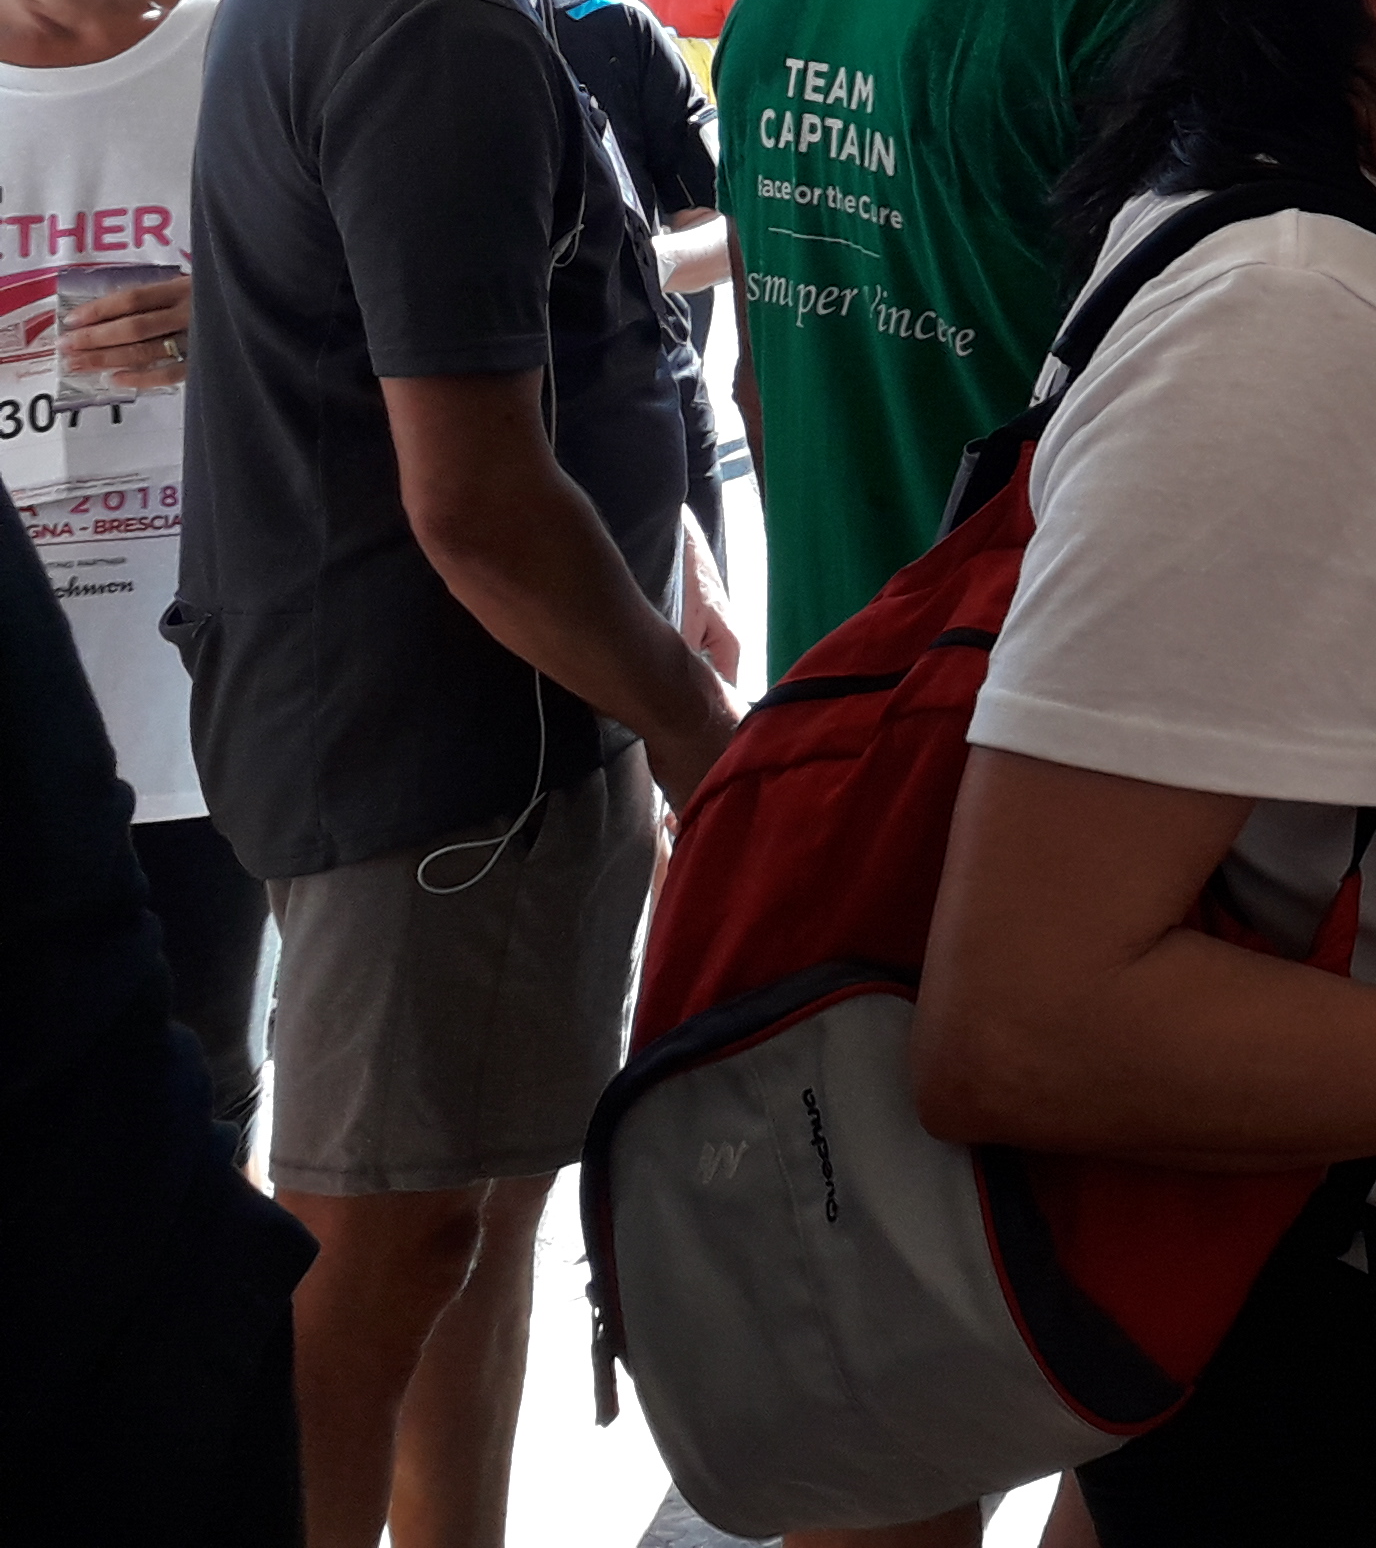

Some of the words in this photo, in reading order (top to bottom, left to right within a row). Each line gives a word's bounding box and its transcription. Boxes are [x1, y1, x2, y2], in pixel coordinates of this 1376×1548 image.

[785, 57, 876, 114] TEAM
[760, 108, 896, 177] CAPTAIN
[0, 205, 173, 259] THER
